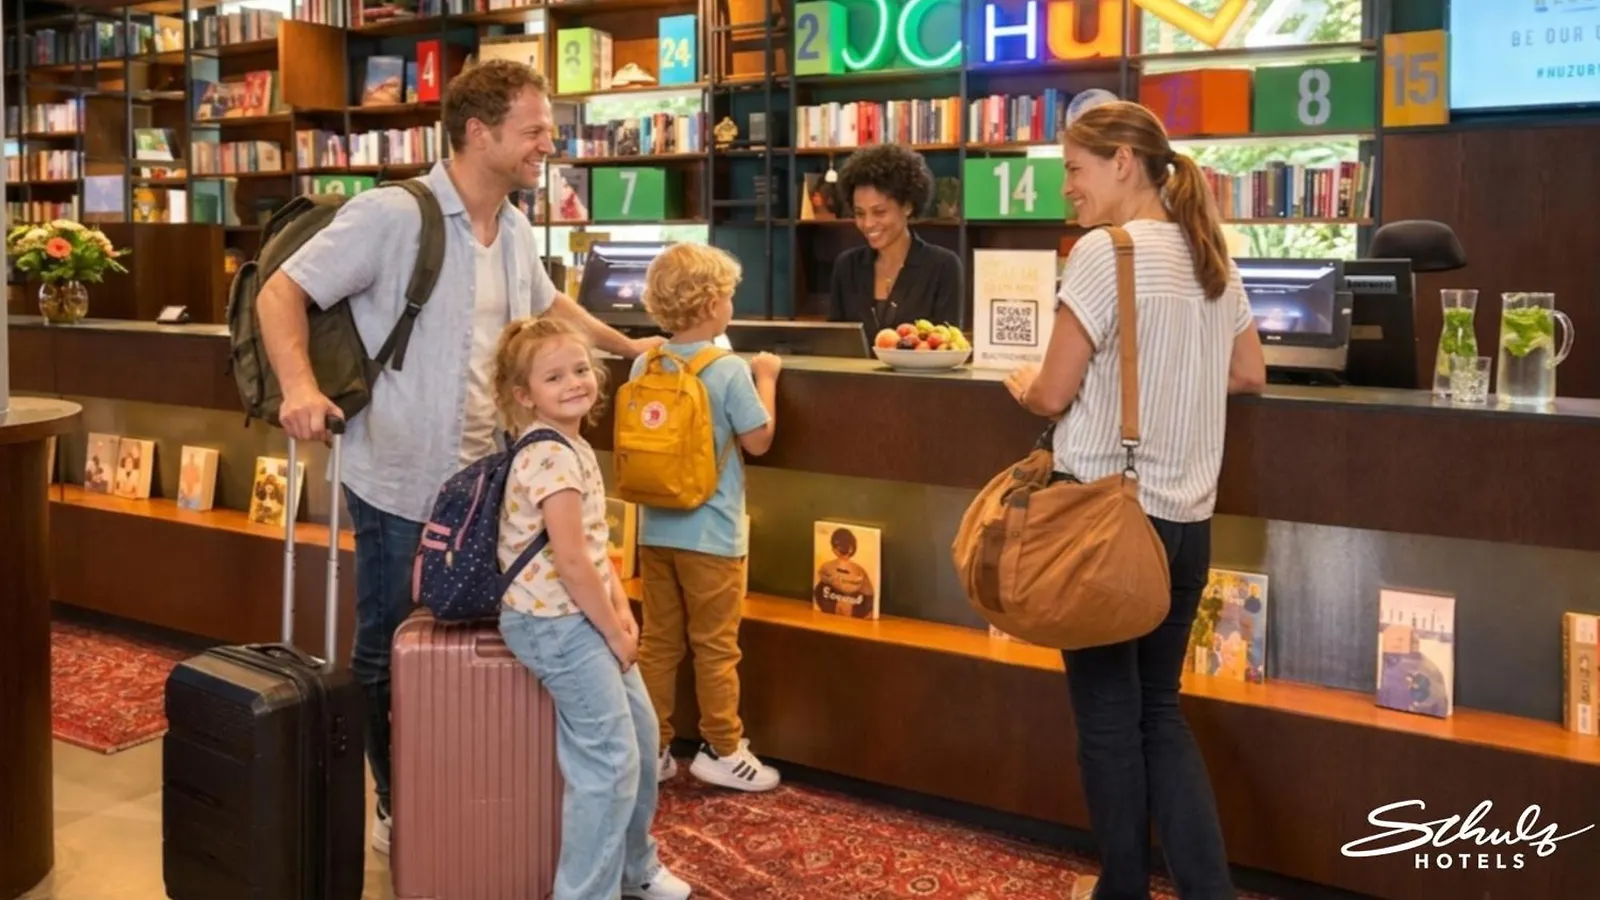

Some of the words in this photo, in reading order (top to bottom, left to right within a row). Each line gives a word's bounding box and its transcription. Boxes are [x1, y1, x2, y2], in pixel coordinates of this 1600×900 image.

[660, 37, 691, 68] 24
[797, 12, 819, 60] 2
[1511, 29, 1534, 47] BE
[1546, 26, 1583, 44] OUR
[421, 51, 435, 88] 4
[1386, 53, 1439, 107] 15
[1537, 63, 1600, 78] #NUZUR
[1298, 67, 1331, 126] 8
[620, 171, 638, 215] 7
[993, 160, 1037, 216] 14
